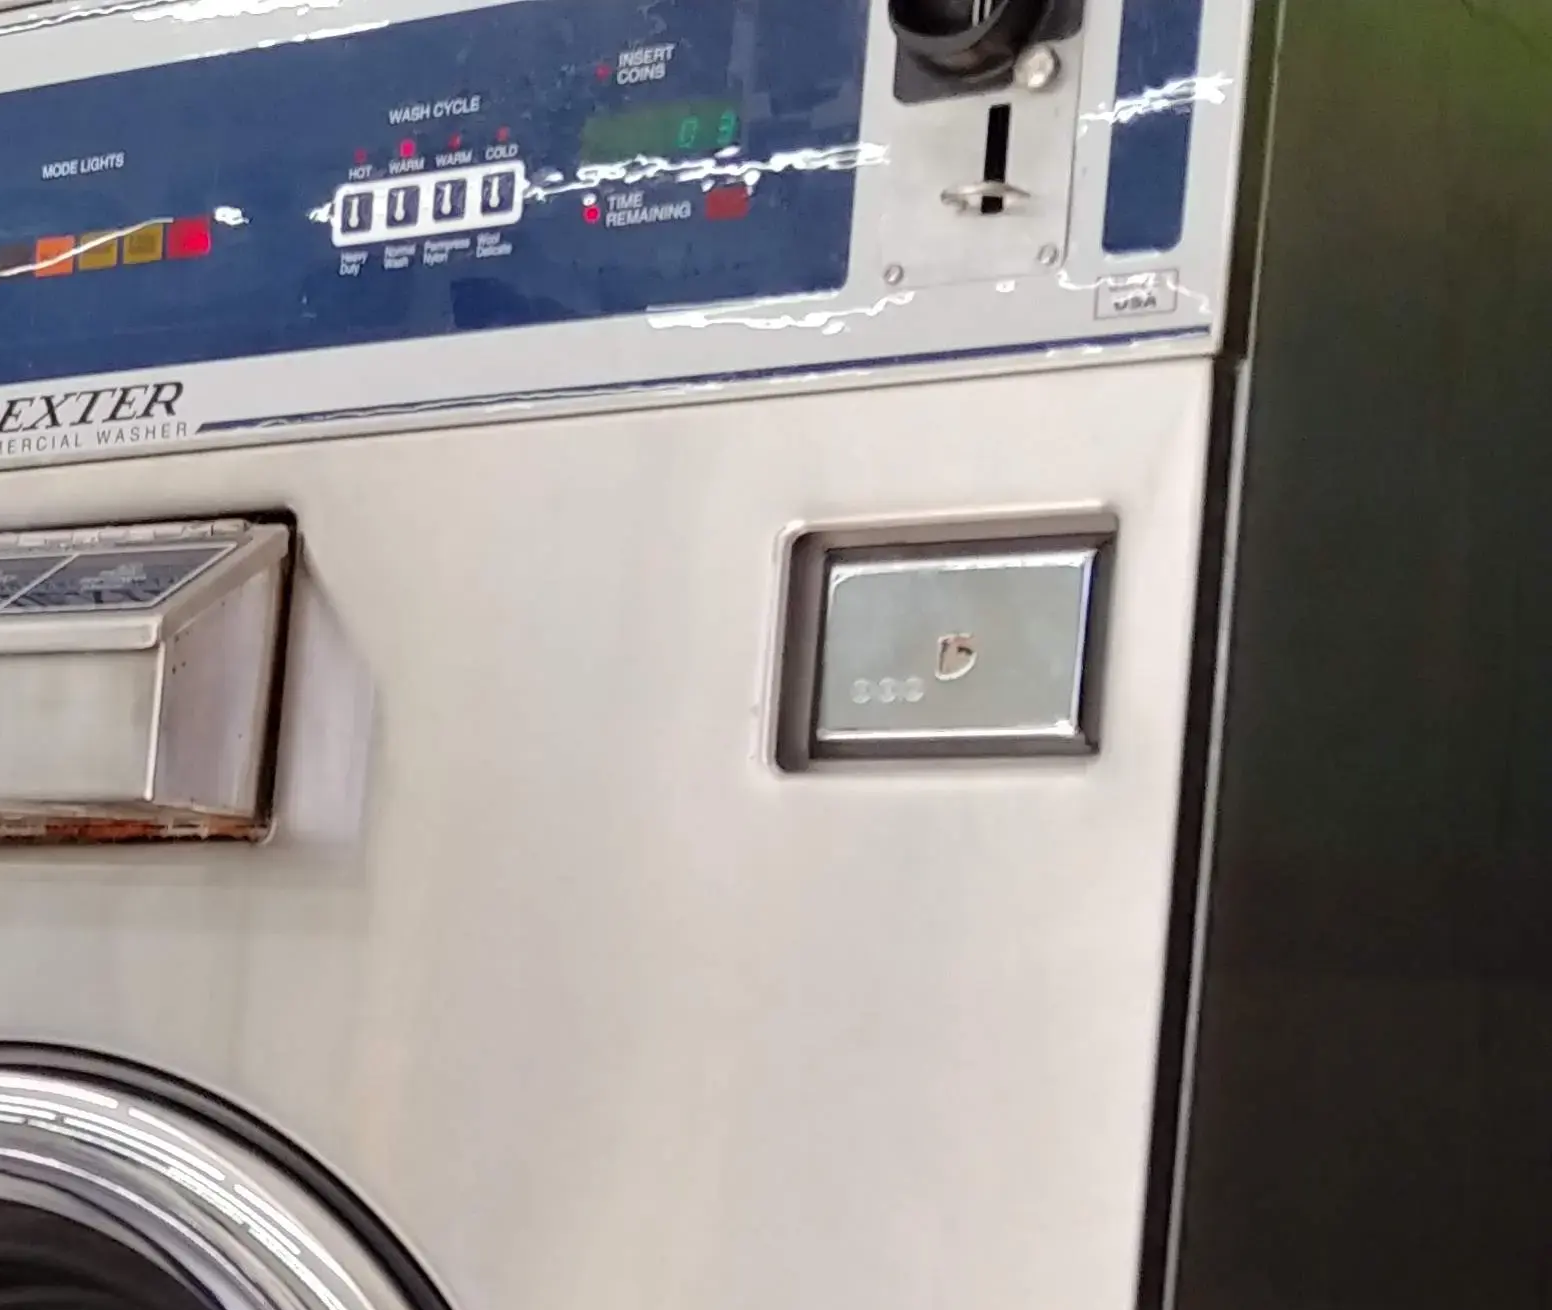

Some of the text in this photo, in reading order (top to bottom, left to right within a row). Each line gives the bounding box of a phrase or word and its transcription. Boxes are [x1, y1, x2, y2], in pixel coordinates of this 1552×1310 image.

[618, 43, 675, 68] INSERT
[616, 63, 666, 85] COINS
[389, 95, 480, 125] WASH CYCLE
[435, 150, 473, 168] WARM
[485, 144, 518, 160] COLD
[42, 152, 125, 179] MODE LIGHTS
[348, 165, 373, 180] HOT
[389, 157, 425, 175] WARM
[607, 190, 644, 210] TIME
[605, 200, 691, 228] REMAINING
[97, 421, 188, 446] WASHER
